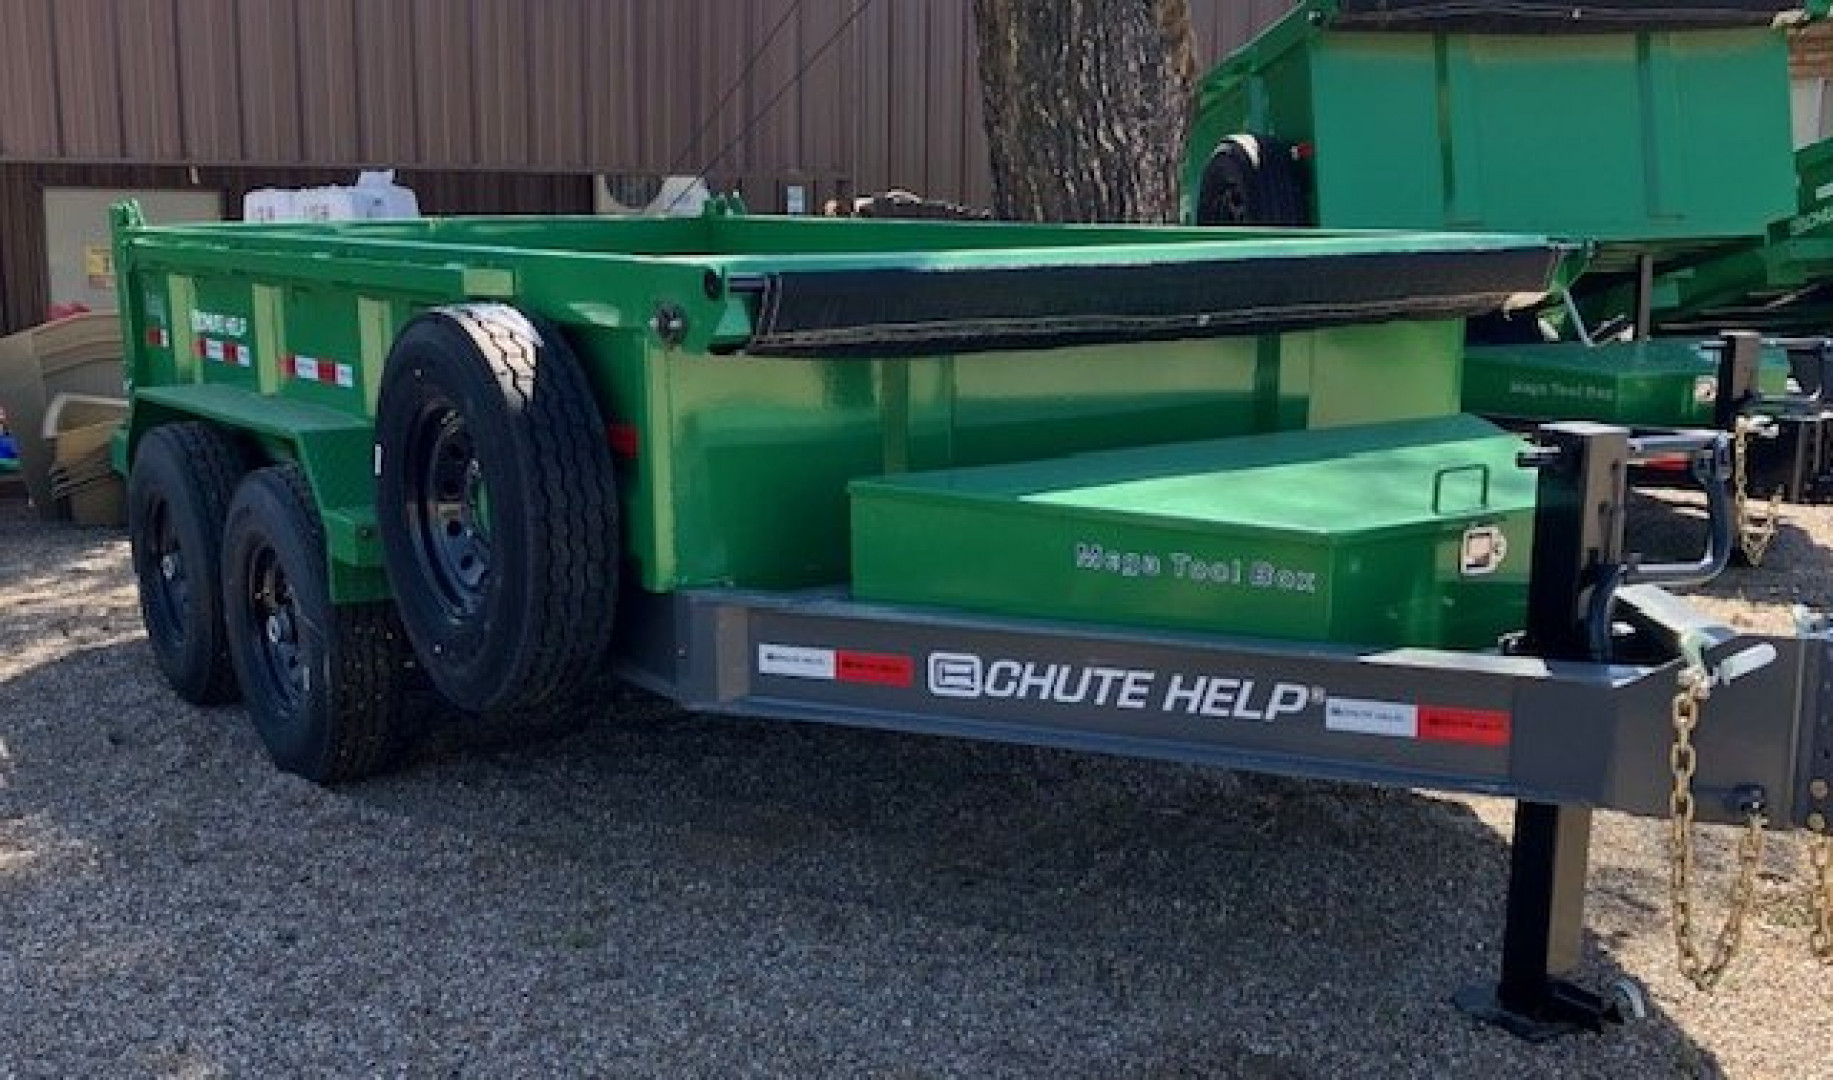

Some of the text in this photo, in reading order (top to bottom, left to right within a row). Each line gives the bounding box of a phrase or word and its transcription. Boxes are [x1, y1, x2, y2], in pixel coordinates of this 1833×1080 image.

[1170, 552, 1241, 585] Tool
[1250, 561, 1316, 594] Box
[985, 660, 1308, 721] CHUTE HELP
